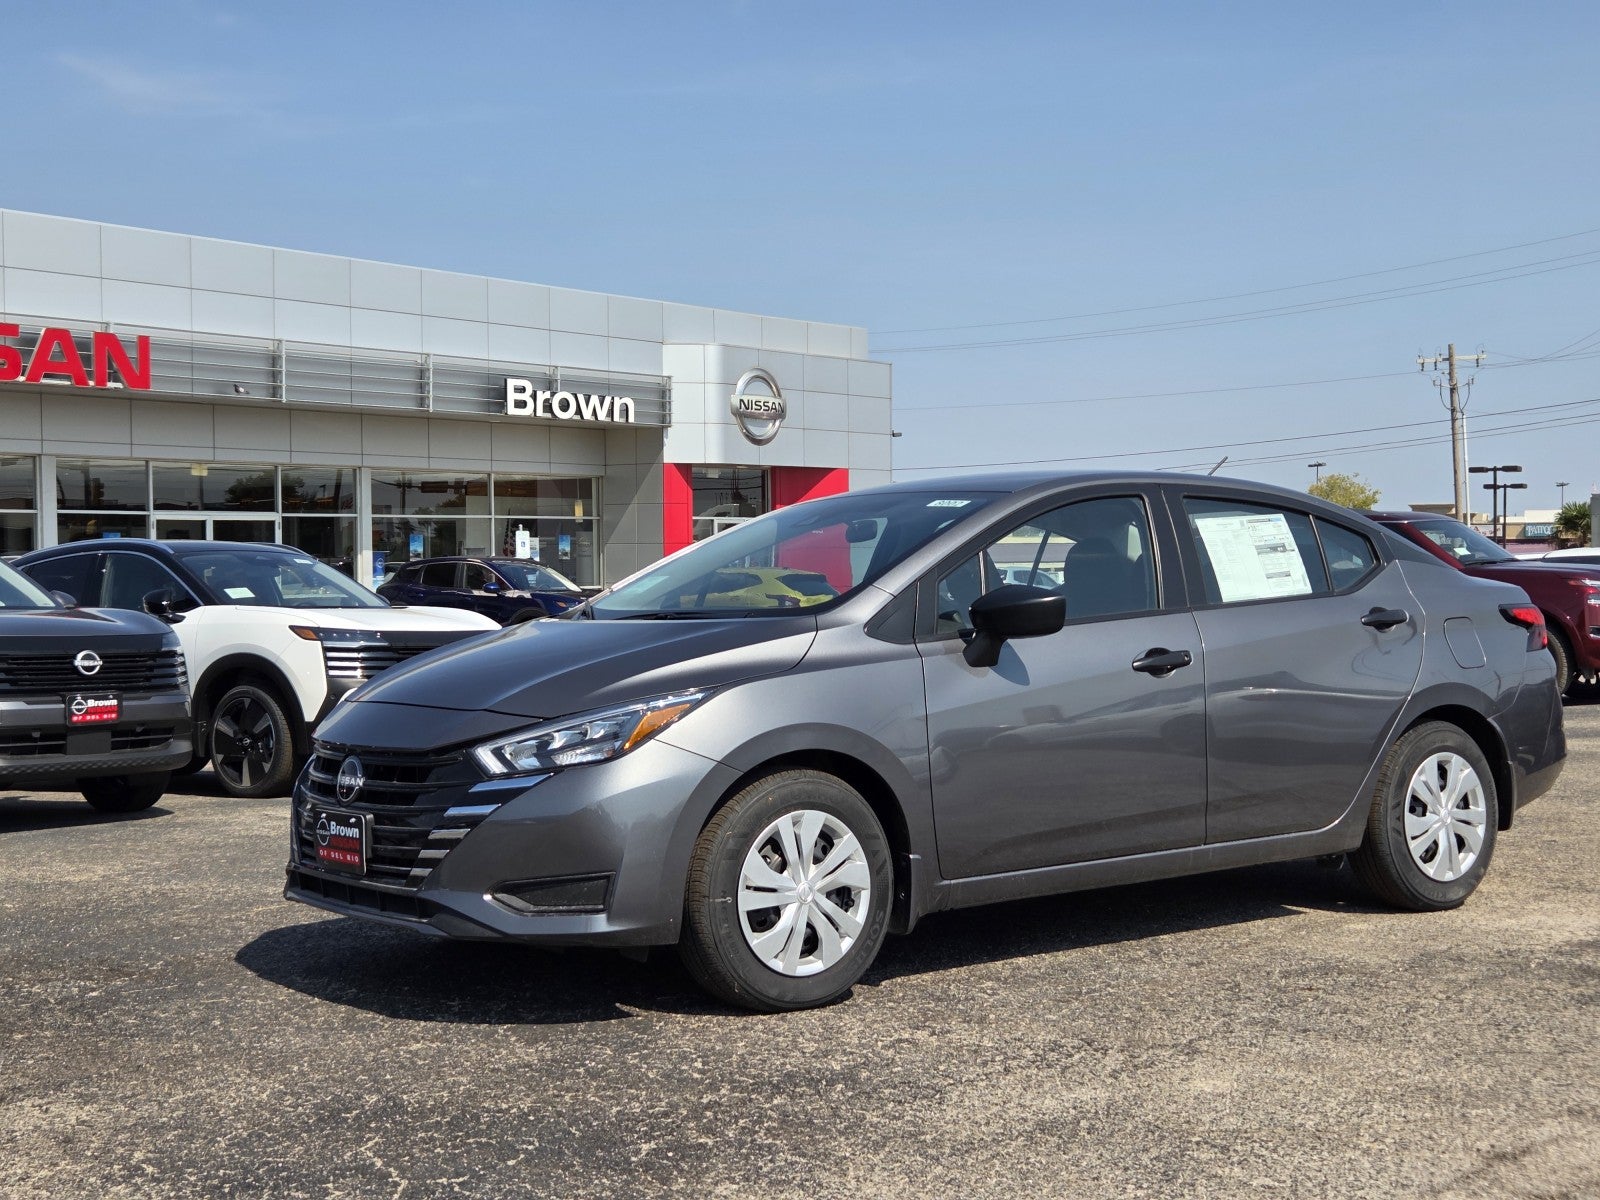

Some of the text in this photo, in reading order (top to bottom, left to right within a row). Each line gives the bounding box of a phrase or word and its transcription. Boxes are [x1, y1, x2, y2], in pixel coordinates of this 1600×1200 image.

[505, 378, 635, 423] Brown
[739, 398, 785, 413] NISSAN
[87, 699, 118, 707] Brown
[330, 821, 360, 838] Brown
